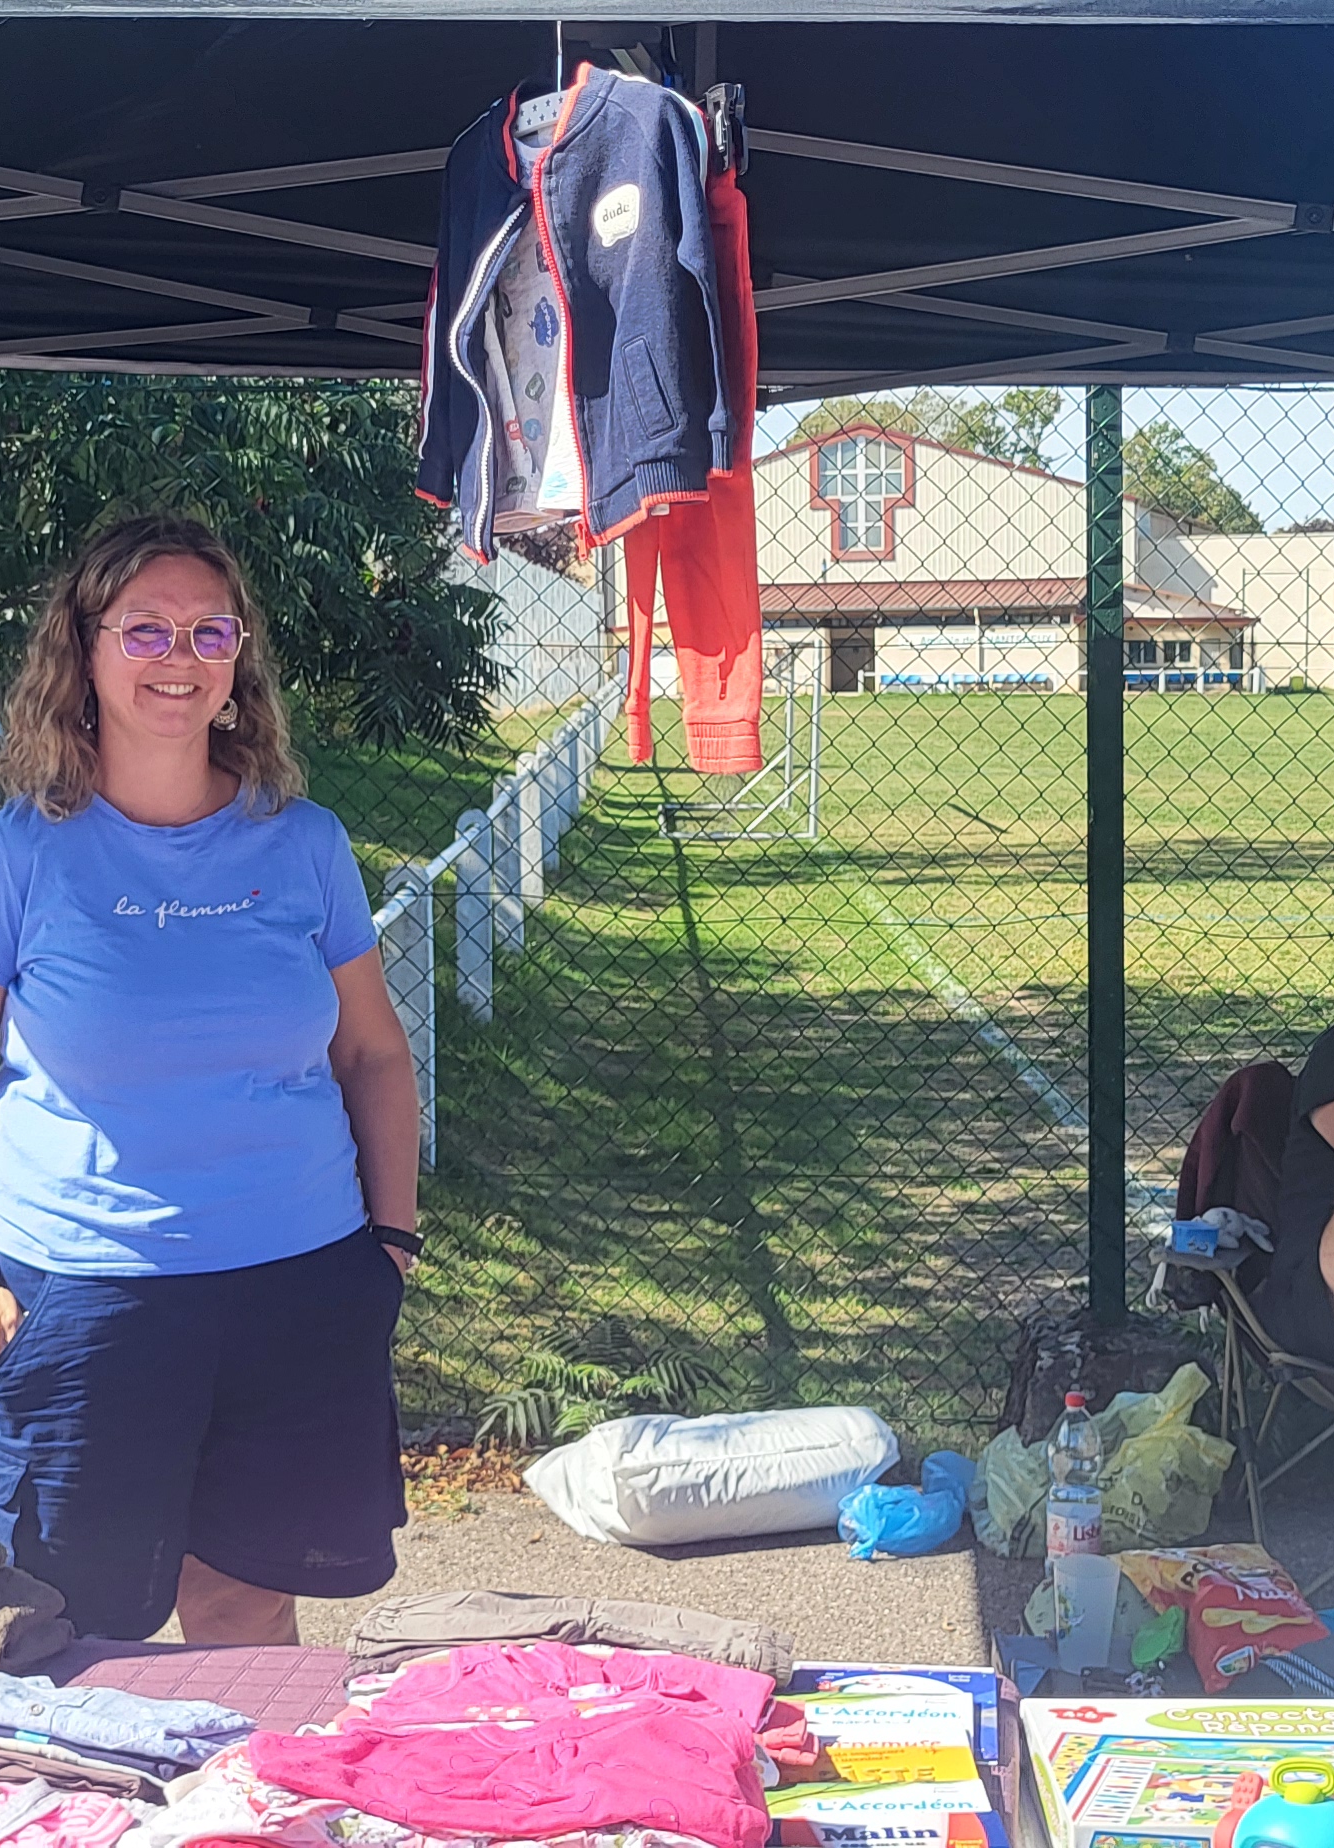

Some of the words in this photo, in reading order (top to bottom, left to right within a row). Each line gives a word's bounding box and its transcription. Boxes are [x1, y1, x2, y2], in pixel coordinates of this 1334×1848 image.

[113, 895, 146, 915] la
[154, 898, 255, 929] flemme
[820, 1826, 940, 1842] Malin
